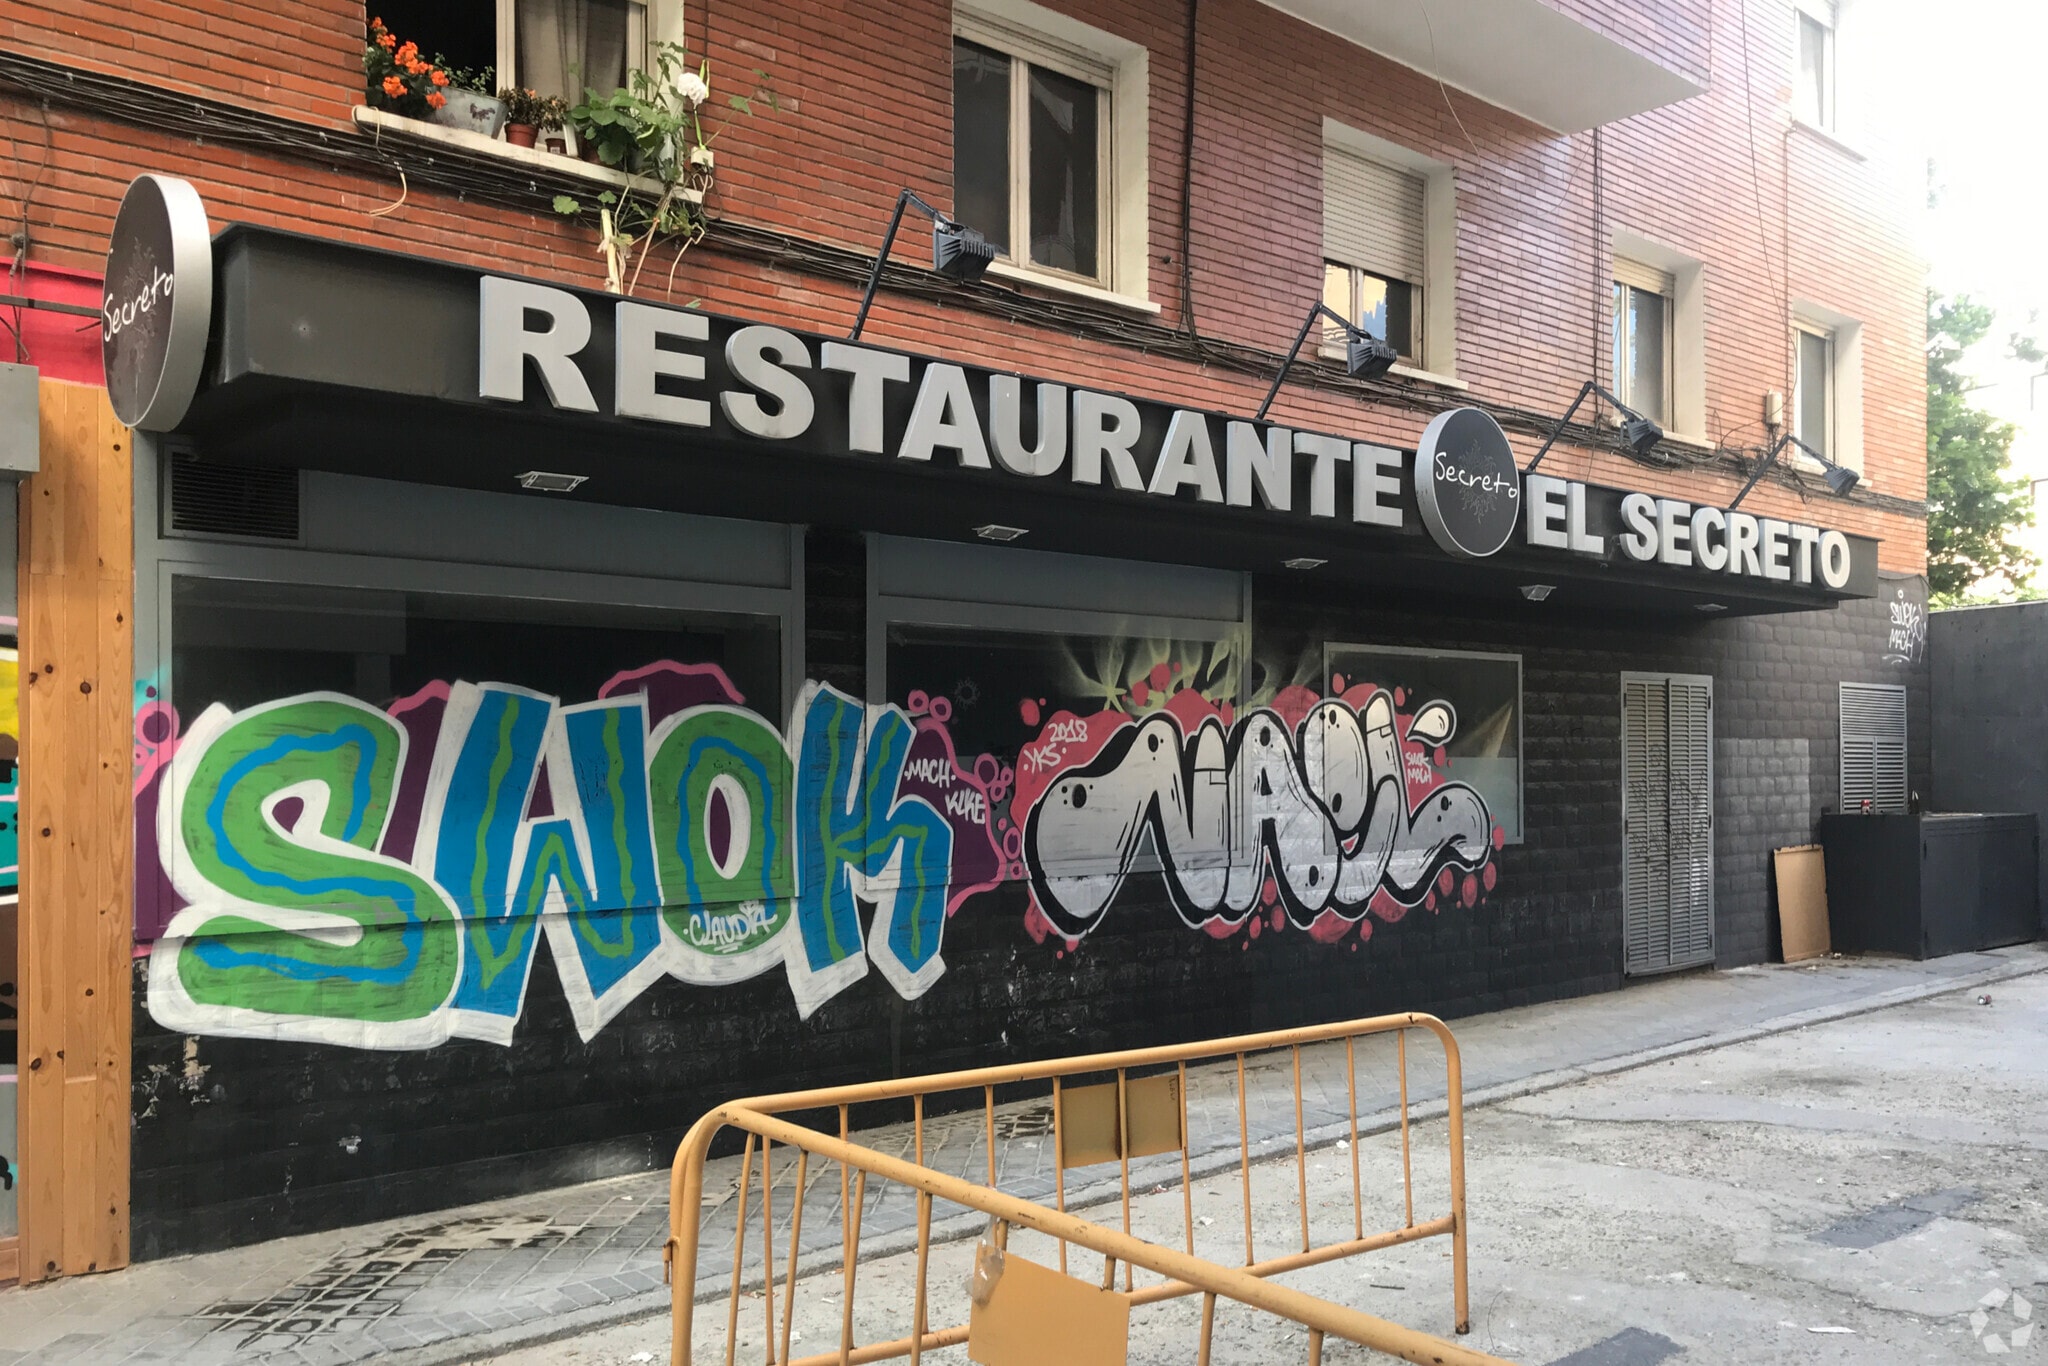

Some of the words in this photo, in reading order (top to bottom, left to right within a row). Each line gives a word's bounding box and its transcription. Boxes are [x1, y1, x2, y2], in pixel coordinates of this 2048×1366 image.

[104, 265, 174, 342] Secreto
[479, 275, 1404, 527] RESTAURANTE
[1435, 451, 1518, 499] Secreto
[1526, 474, 1604, 554] EL
[1619, 493, 1851, 588] SECRETO
[1048, 719, 1088, 742] 2018
